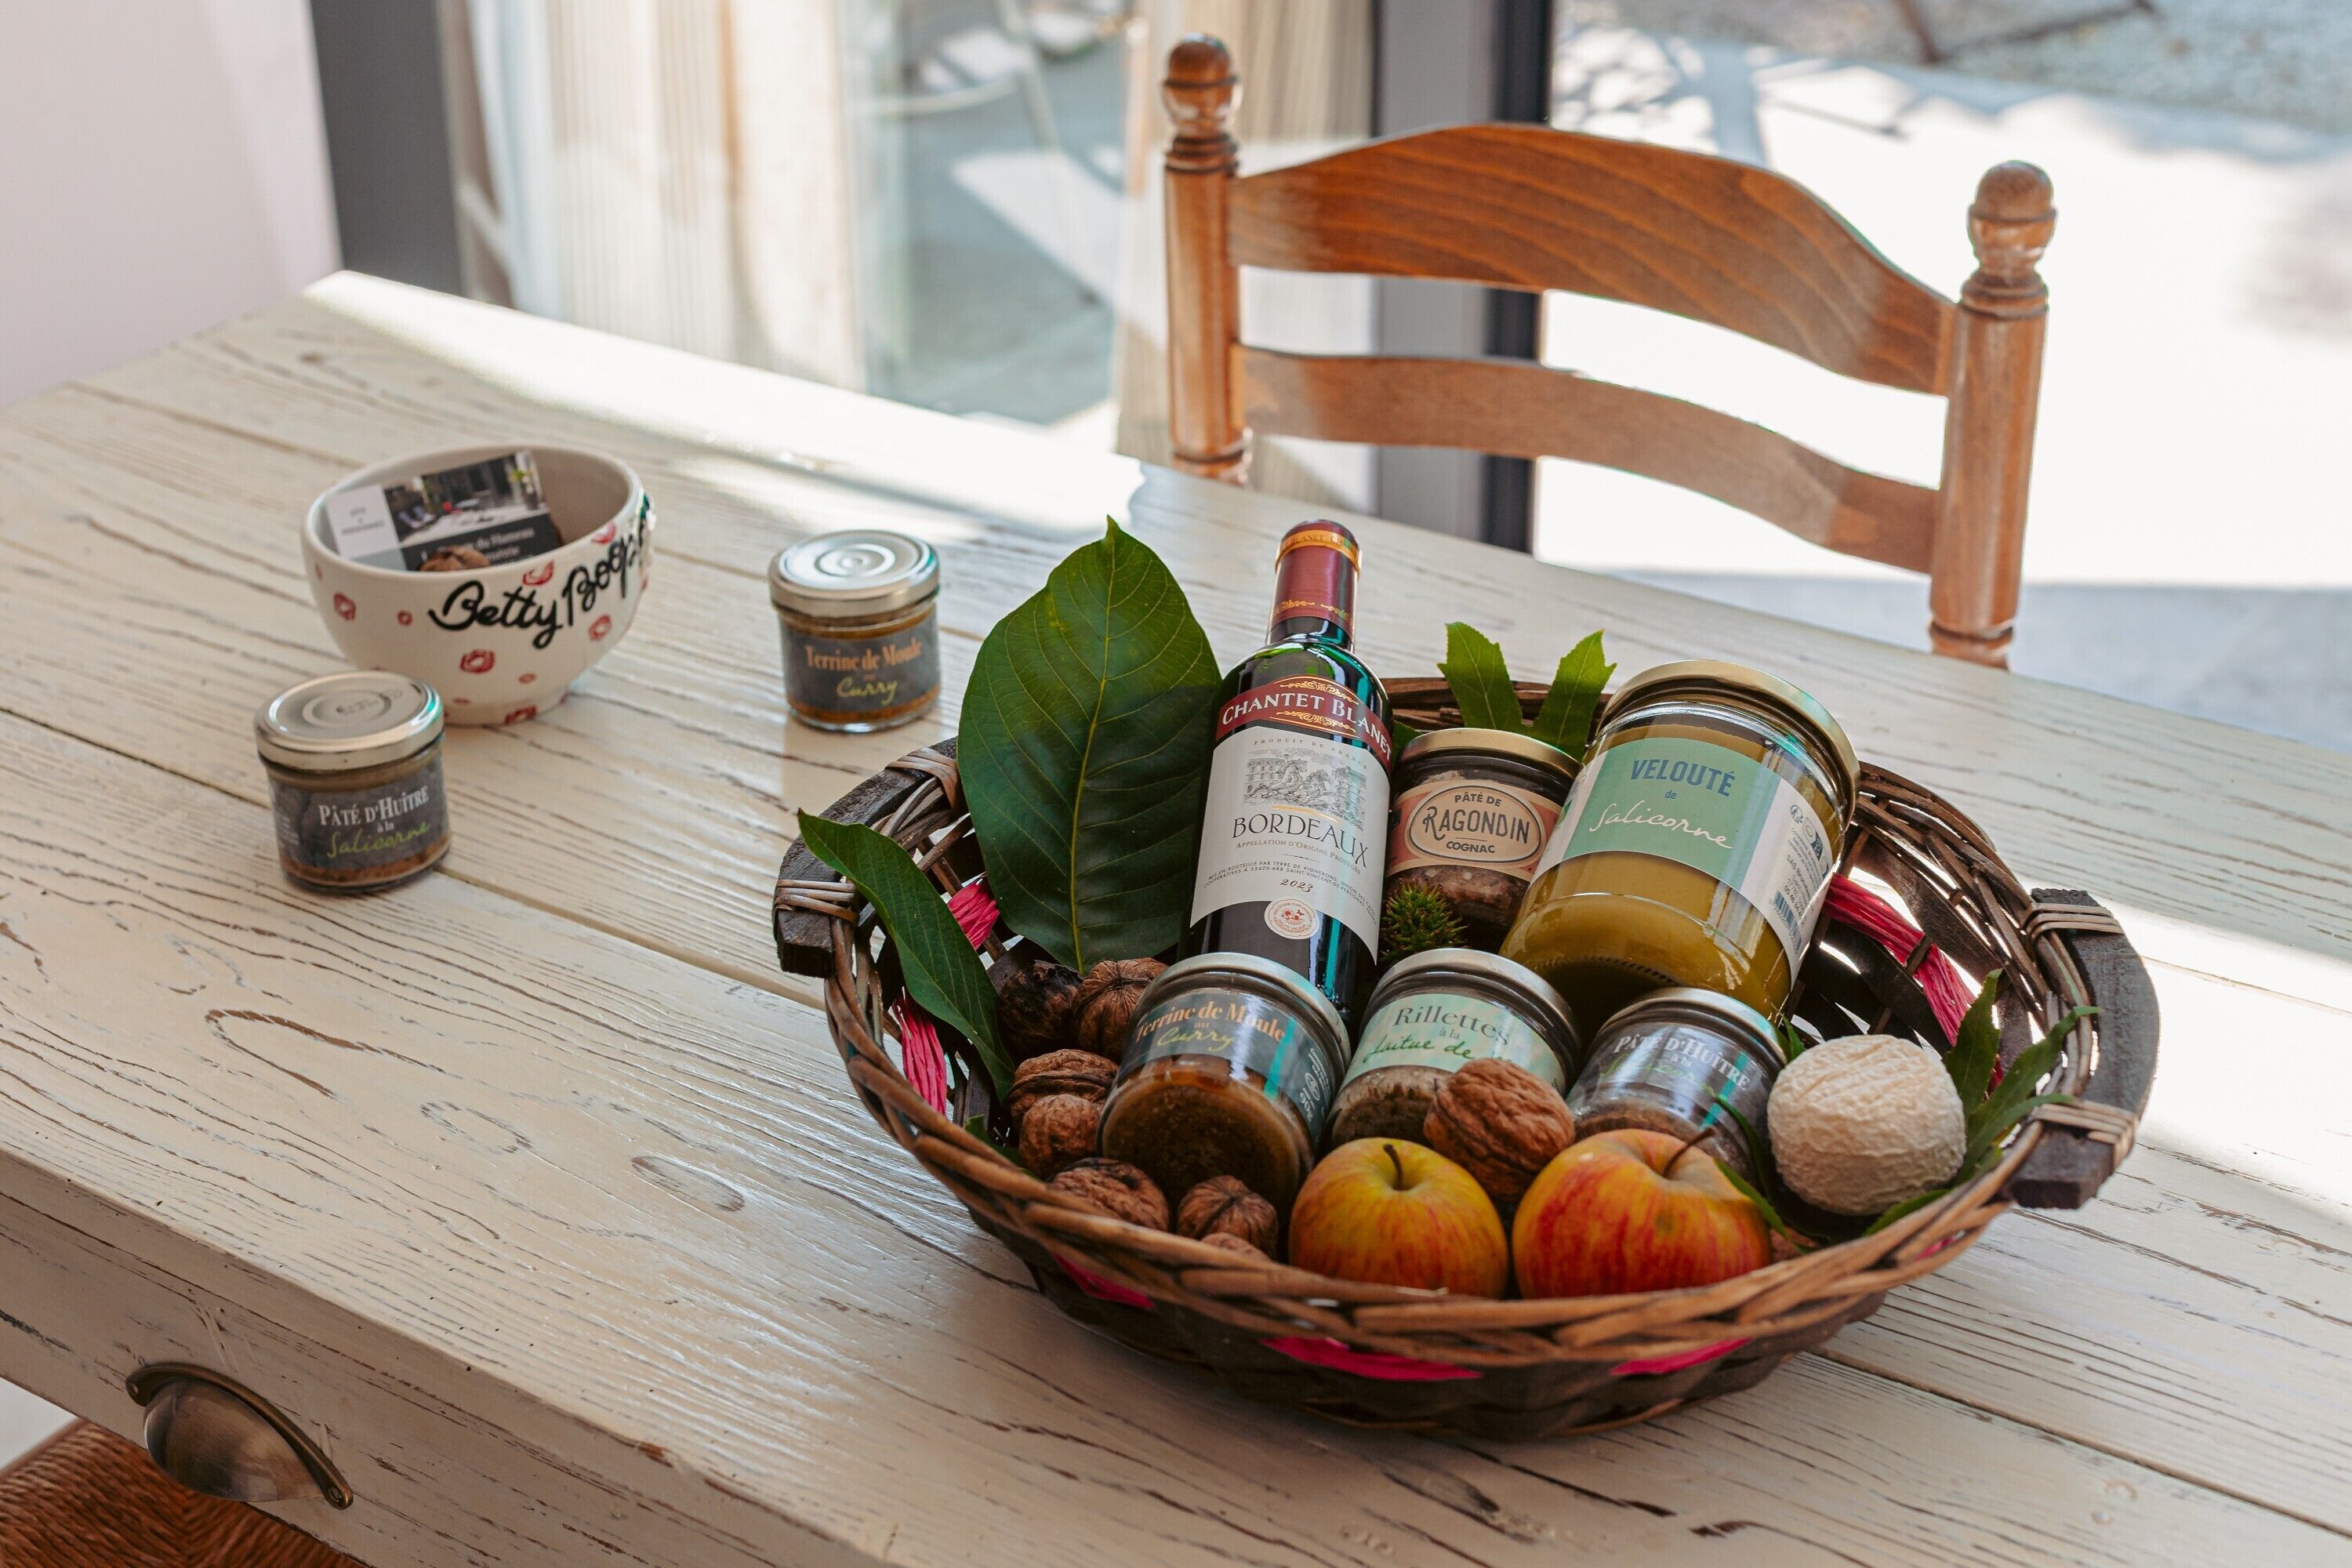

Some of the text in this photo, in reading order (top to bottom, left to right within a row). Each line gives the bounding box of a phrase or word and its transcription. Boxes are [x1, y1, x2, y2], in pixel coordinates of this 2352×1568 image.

[428, 580, 563, 649] Betty
[862, 648, 880, 670] de
[837, 677, 898, 706] Curry
[1222, 692, 1392, 760] CHANTET BLANET
[1630, 759, 1736, 797] VELOUTÉ
[318, 785, 430, 826] PÂTÉ D'HUÎTRE
[1454, 792, 1502, 808] PÂTÉ DE
[1664, 789, 1676, 800] de
[1422, 806, 1530, 844] RAGONDIN
[1589, 800, 1733, 849] Salicorne
[327, 822, 430, 858] Salicorne
[1232, 813, 1368, 869] BORDEAUX
[1236, 840, 1287, 848] APPELLATION
[1288, 841, 1328, 855] D'ORIGINE
[1446, 840, 1495, 854] COGNAC
[1279, 878, 1313, 893] 2023
[1198, 1001, 1223, 1019] de
[1157, 1026, 1236, 1052] Curry
[1393, 1005, 1510, 1047] Rillettes
[1439, 1028, 1461, 1040] à la
[1443, 1040, 1475, 1059] de
[1665, 1036, 1751, 1091] D'HUÎTRE
